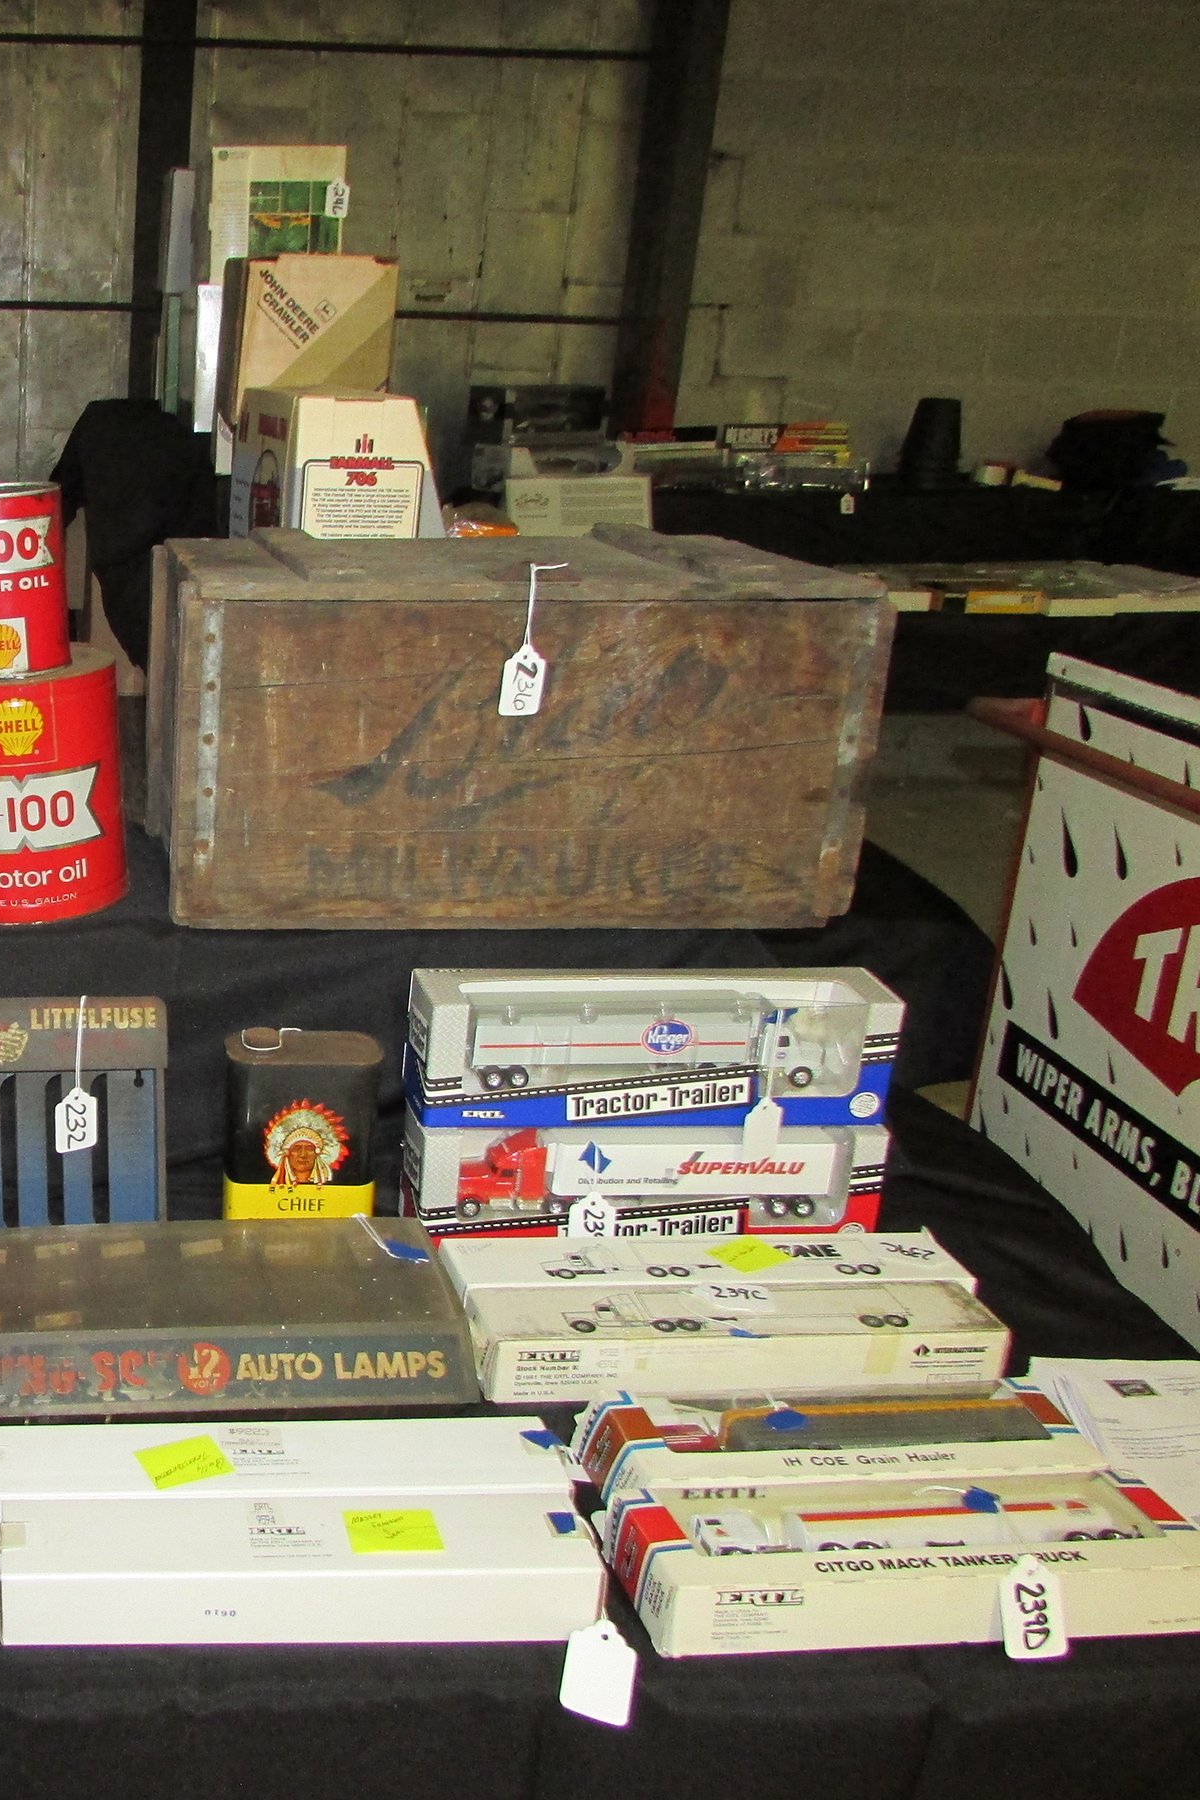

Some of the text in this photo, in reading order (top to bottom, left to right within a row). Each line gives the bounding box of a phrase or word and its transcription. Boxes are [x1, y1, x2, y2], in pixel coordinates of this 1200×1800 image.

[260, 269, 287, 300] JOHN
[287, 299, 319, 335] DEERE
[263, 292, 310, 344] CRAWLER
[345, 471, 378, 486] 706
[19, 577, 49, 591] OIL
[511, 660, 539, 712] 236
[57, 857, 88, 882] oil
[10, 898, 29, 907] U.S.
[33, 891, 78, 907] GALLON
[30, 1007, 157, 1030] LITTELFUSE
[647, 1025, 691, 1053] Kroger
[572, 1082, 744, 1118] Tractor-Trailer
[461, 1110, 505, 1118] ERTL
[1015, 1043, 1082, 1122] WIPER
[1083, 1098, 1161, 1188] ARMS,
[65, 1103, 87, 1149] 232
[676, 1153, 806, 1176] SUPERVALU
[577, 1177, 625, 1185] Distibution
[277, 1198, 326, 1212] CHIEF
[709, 1286, 768, 1301] 239C
[236, 1350, 447, 1382] AUTO LAMPS
[517, 1350, 580, 1363] ERTL
[782, 1451, 956, 1467] IH COE Grain Hauler
[814, 1560, 875, 1574] CITGO
[880, 1556, 938, 1571] MACK
[939, 1552, 1018, 1568] TANKER
[715, 1588, 805, 1607] ERTL
[1013, 1582, 1052, 1651] 239D
